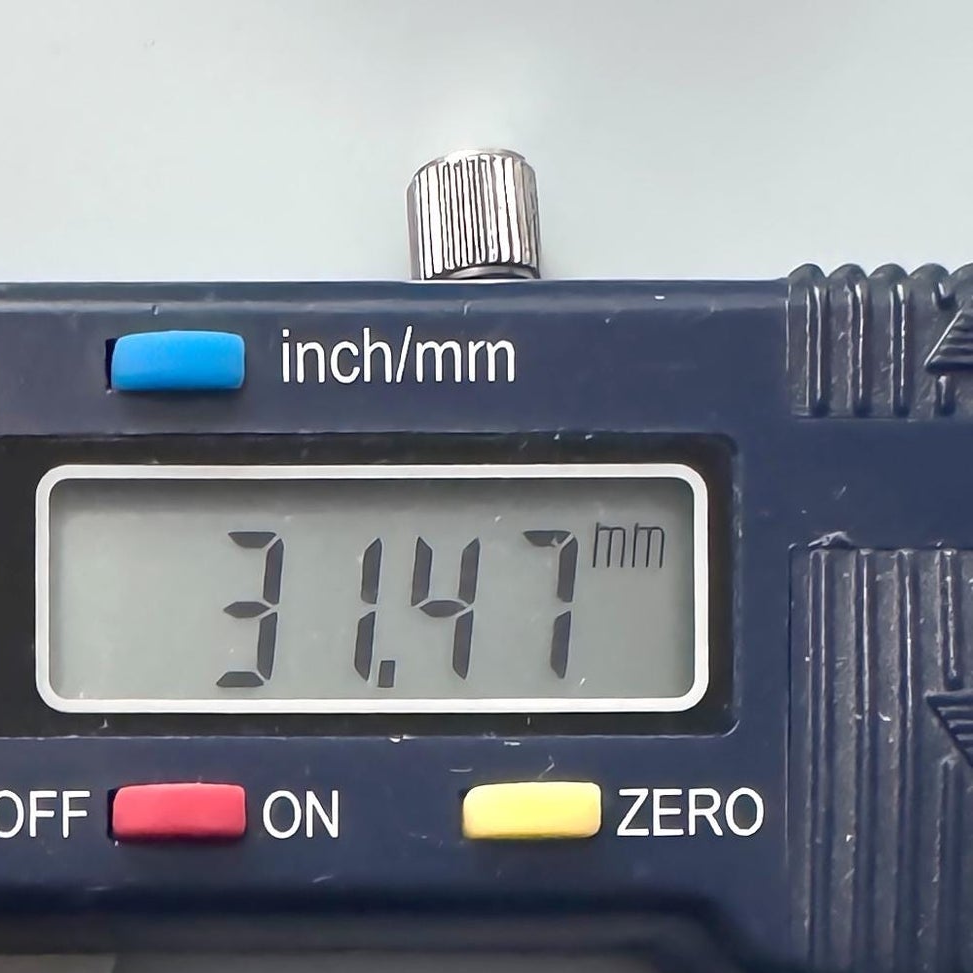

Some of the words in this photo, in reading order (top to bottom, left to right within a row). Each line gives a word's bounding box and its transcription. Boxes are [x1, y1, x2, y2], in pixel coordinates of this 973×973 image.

[282, 325, 515, 384] inch/mm
[217, 529, 579, 688] 31.47
[592, 522, 666, 569] mm
[262, 789, 339, 839] ON
[616, 786, 764, 837] ZERO
